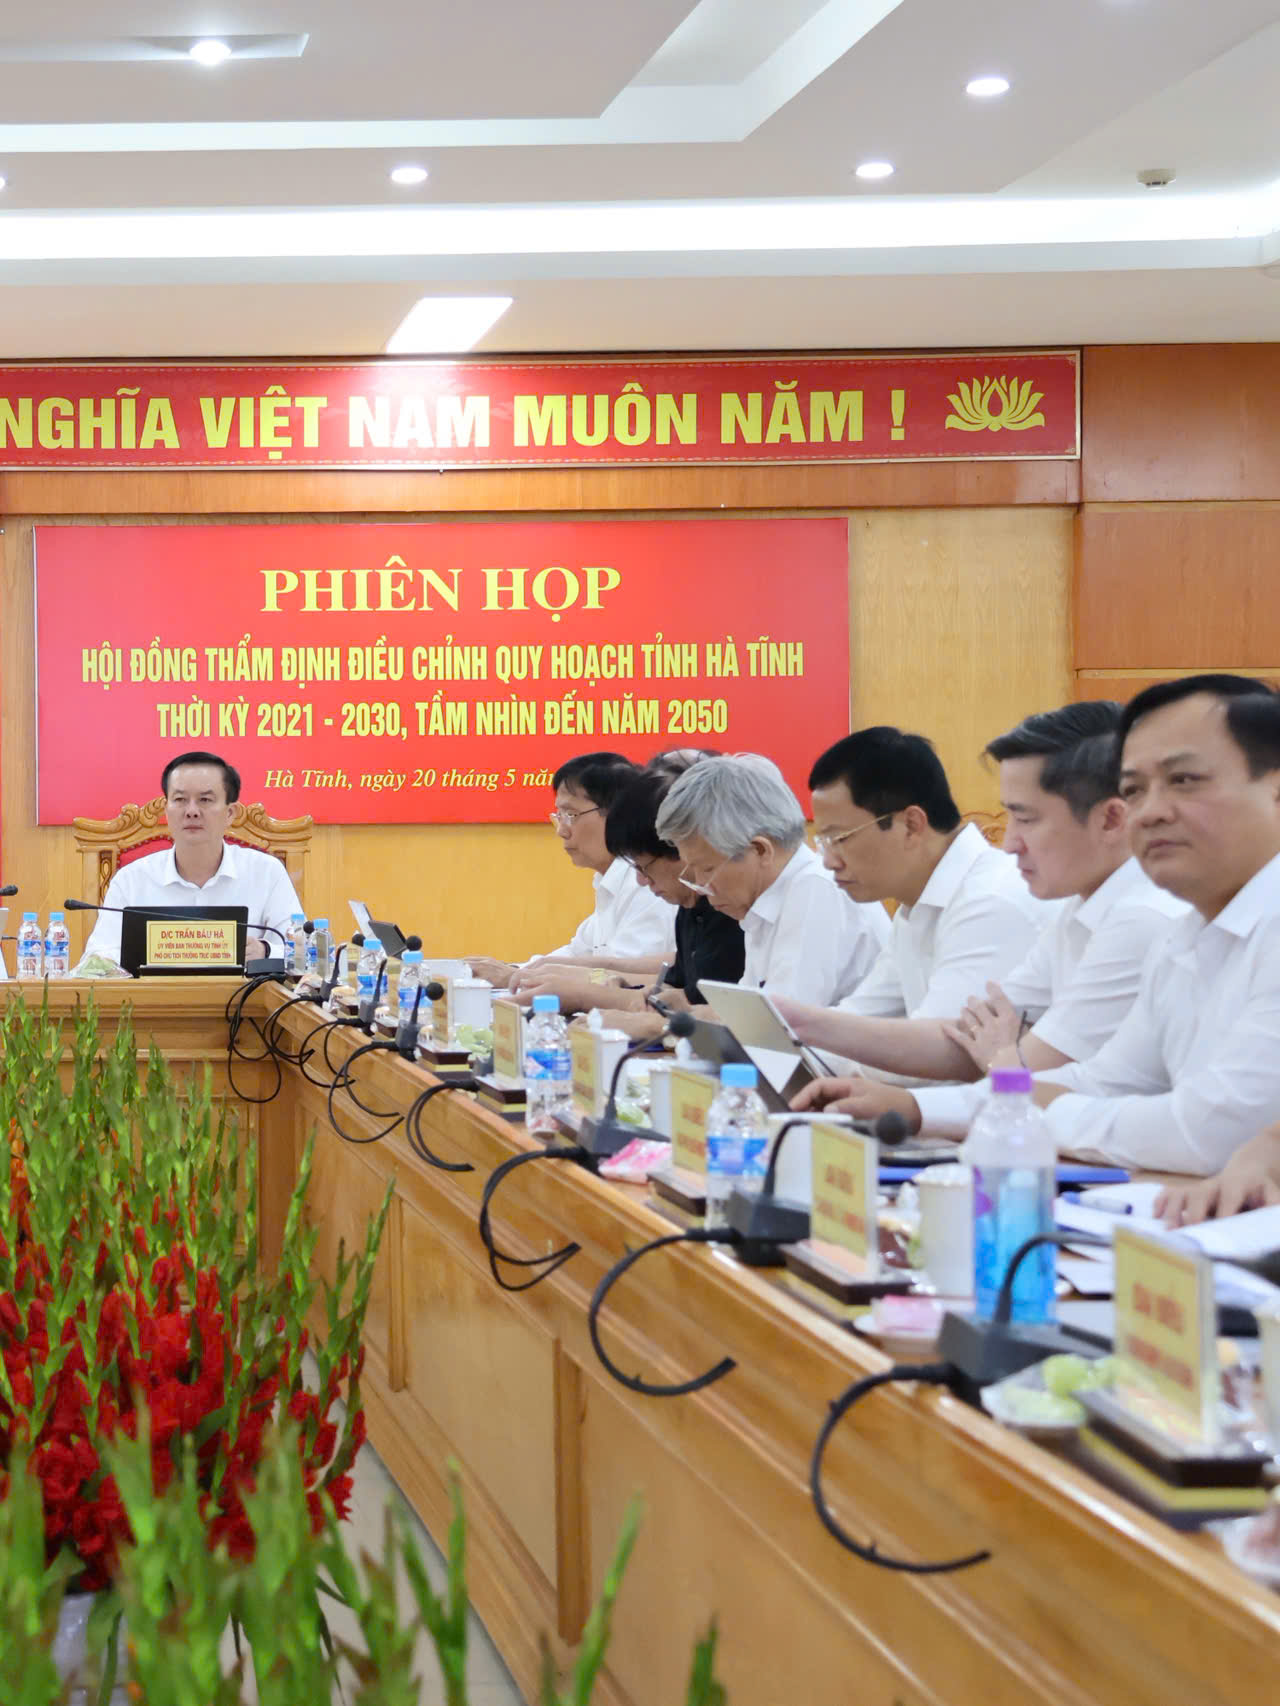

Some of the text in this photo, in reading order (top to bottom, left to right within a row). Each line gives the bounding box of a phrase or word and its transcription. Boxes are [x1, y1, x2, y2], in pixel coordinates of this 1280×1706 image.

[200, 384, 328, 461] VIỆT
[348, 396, 490, 450] NAM
[513, 382, 698, 448] MUÔN
[720, 380, 864, 444] NĂM
[891, 390, 905, 441] !
[260, 554, 621, 623] PHIÊN HỌP
[82, 632, 804, 691] HỘI ĐỒNG THẨM ĐỊNH ĐIỀU CHỈNH QUY HOẠCH TỈNH HÀ TĨNH
[156, 690, 728, 740] THỜI KỲ 2021 - 2030, TẦM NHÌN ĐẾN NĂM 2050
[263, 769, 294, 788] Hà
[301, 769, 353, 790] Tĩnh,
[359, 769, 407, 792] ngày
[412, 769, 437, 787] 20
[441, 769, 500, 791] tháng
[503, 769, 516, 787] 5
